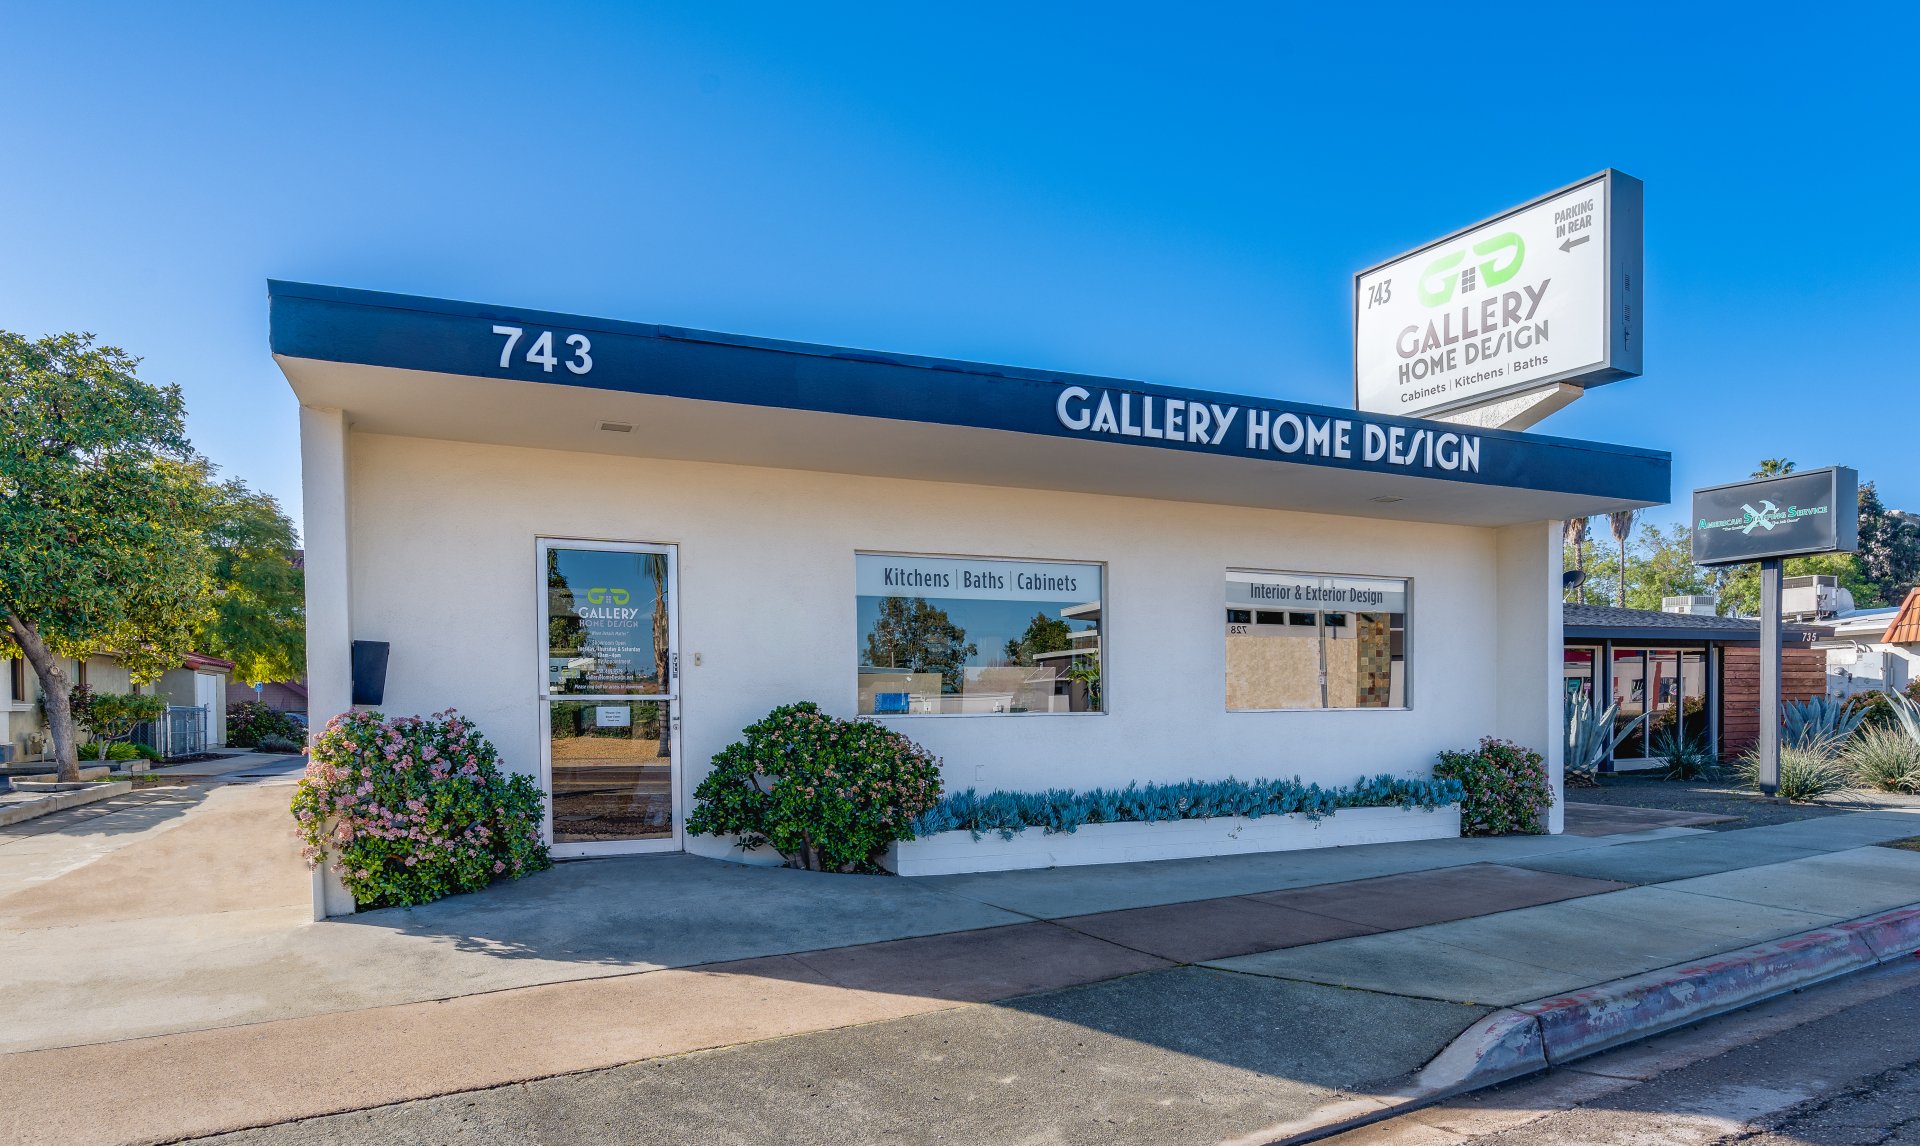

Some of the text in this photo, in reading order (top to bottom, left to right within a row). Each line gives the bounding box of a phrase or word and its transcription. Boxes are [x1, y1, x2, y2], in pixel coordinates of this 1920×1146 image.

[1555, 199, 1593, 224] PARKING
[1557, 215, 1591, 238] IN REAR
[1368, 278, 1392, 309] 743
[1396, 278, 1551, 359] GALLERY
[492, 324, 593, 375] 743
[1398, 320, 1549, 385] HOME DESIGN
[1401, 355, 1549, 403] Cabinets Kitchens Baths
[1056, 386, 1480, 474] GALLERY HOME DESIGN
[884, 567, 1077, 592] Kitchens Baths Cabinets
[1250, 582, 1383, 605] Interior & Exterior Design
[578, 606, 639, 619] GALLERY
[607, 620, 639, 628] DESIGN
[1802, 632, 1817, 642] 735
